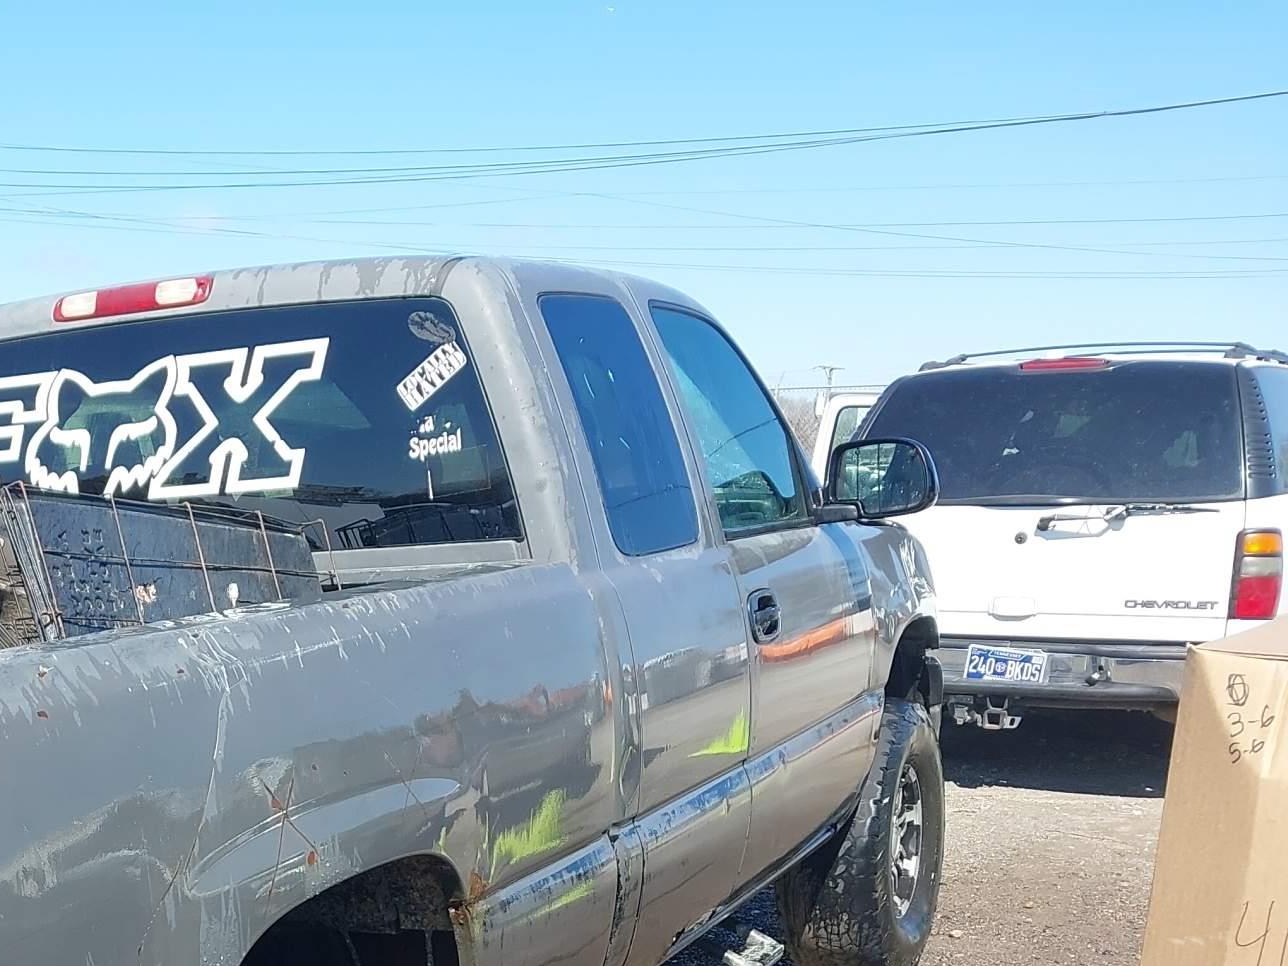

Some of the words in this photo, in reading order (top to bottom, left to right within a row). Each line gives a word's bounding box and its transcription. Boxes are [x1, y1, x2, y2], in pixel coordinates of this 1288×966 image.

[409, 428, 462, 462] Special
[1124, 599, 1220, 611] CHEVROLET
[968, 654, 996, 676] 240
[1226, 704, 1276, 738] 3-6
[1228, 738, 1265, 764] 5-6
